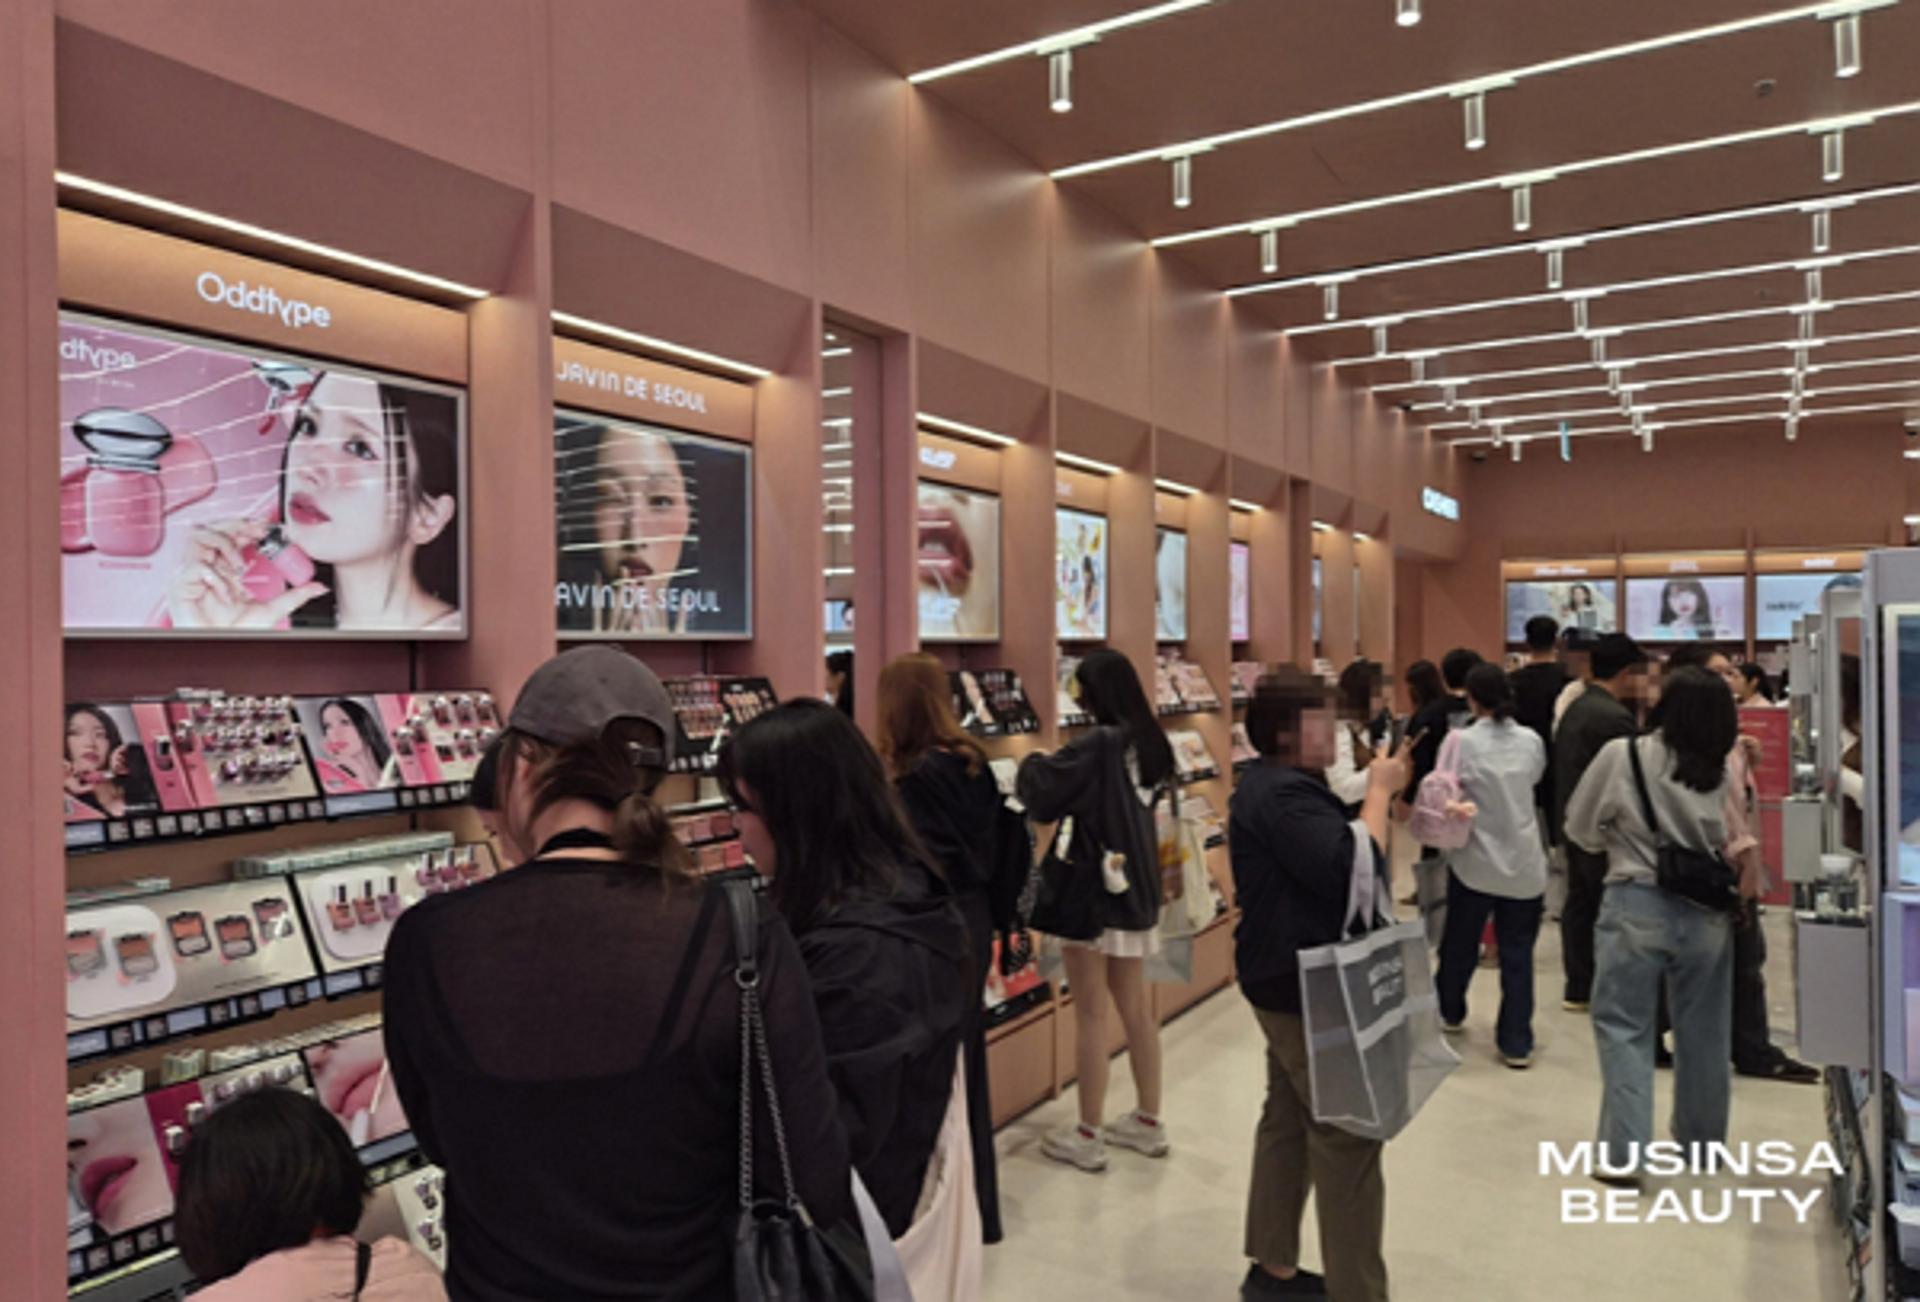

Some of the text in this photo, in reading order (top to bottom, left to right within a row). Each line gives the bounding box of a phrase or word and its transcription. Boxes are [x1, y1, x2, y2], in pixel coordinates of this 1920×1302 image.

[197, 271, 331, 328] Oddtype
[624, 374, 648, 400] DE
[653, 383, 707, 414] SEOUL
[622, 585, 649, 609] DE
[656, 588, 720, 613] SEOUL
